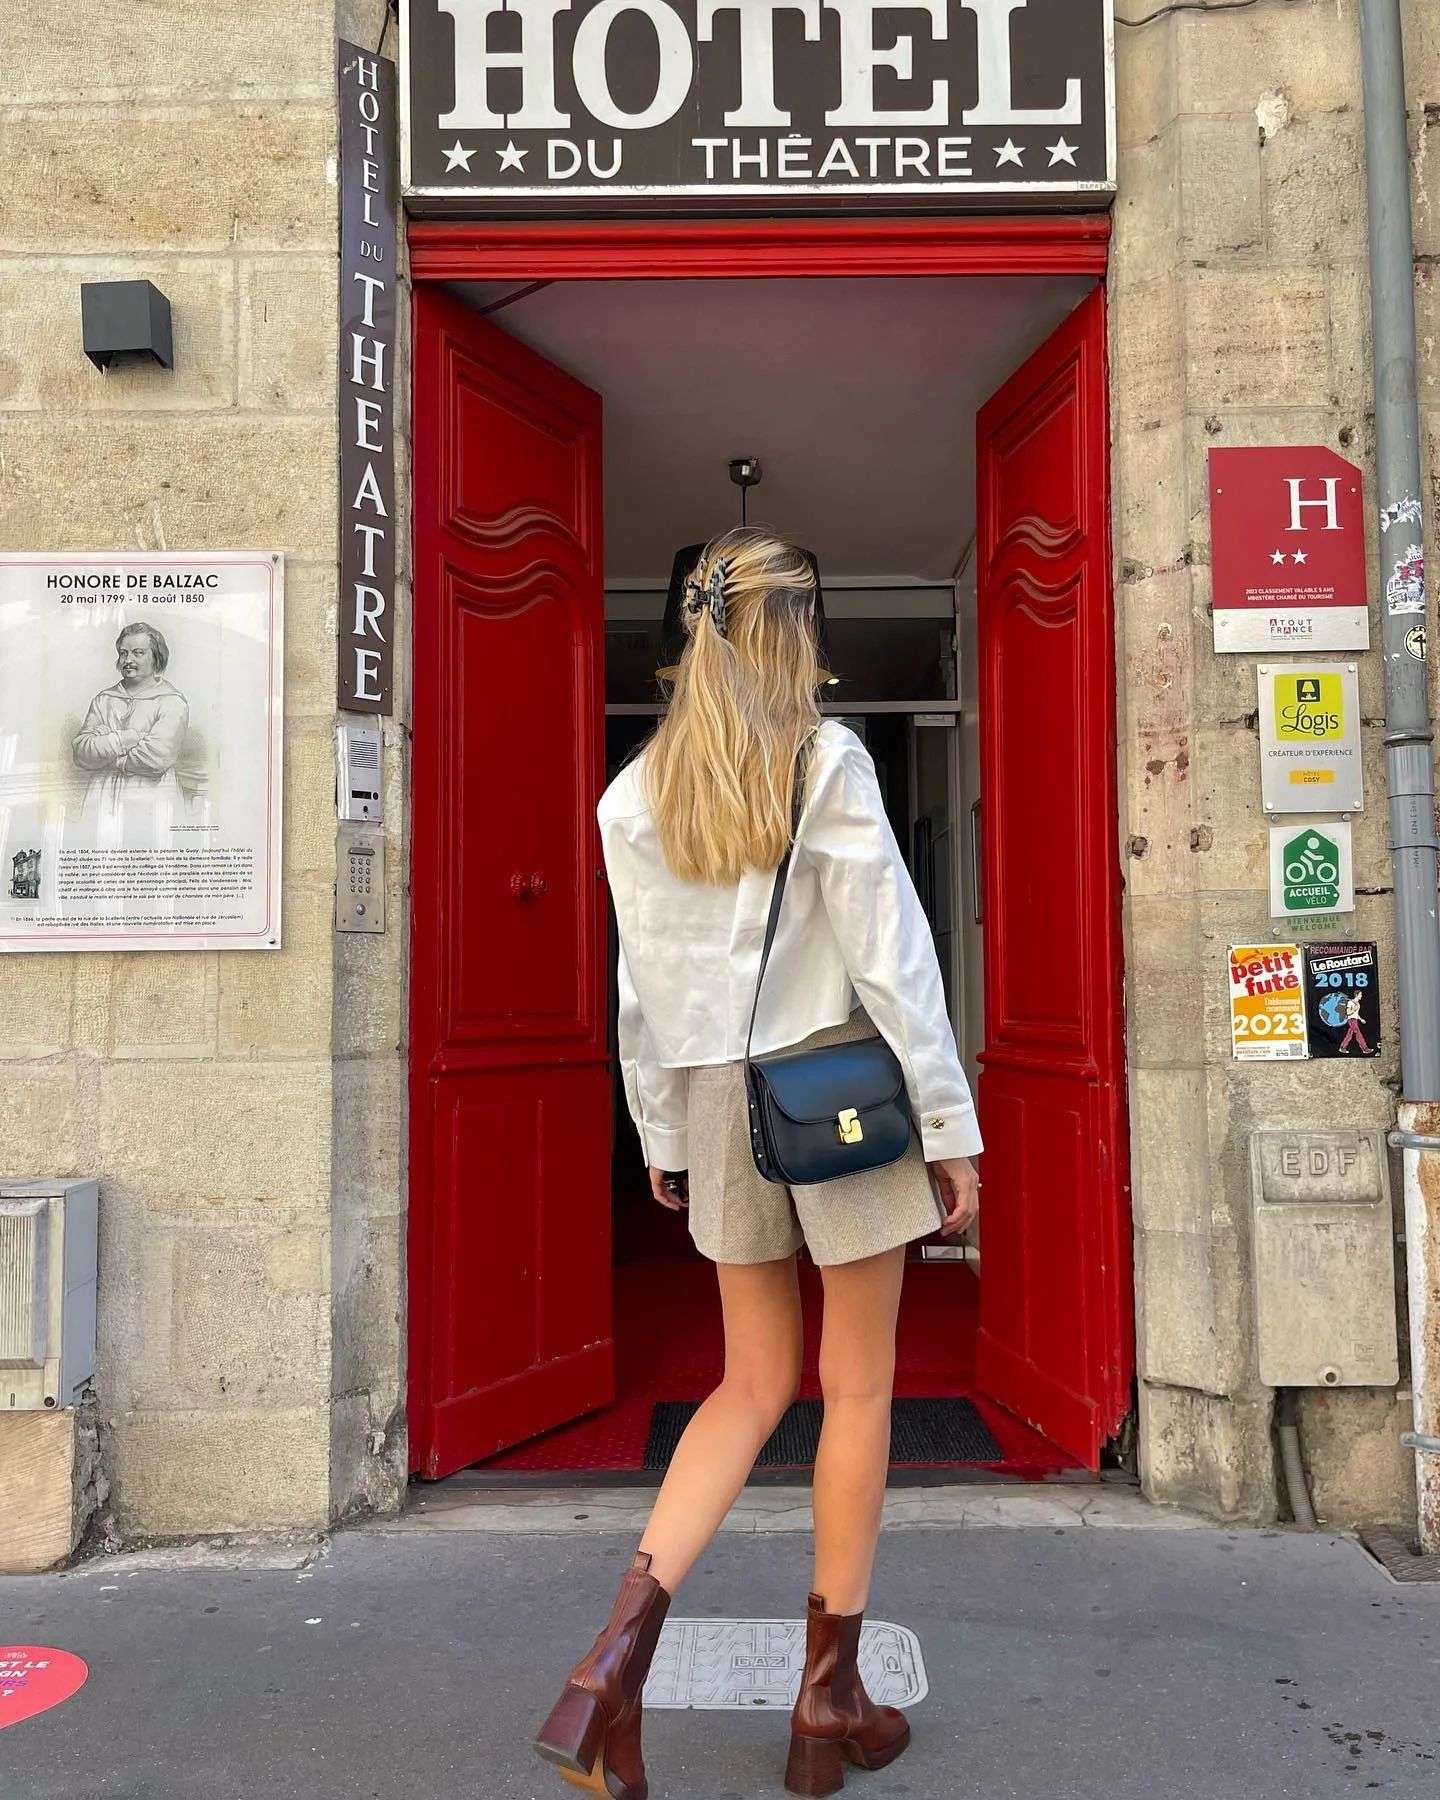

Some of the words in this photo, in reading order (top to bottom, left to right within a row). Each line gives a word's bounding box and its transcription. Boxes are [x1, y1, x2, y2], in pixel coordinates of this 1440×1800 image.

[438, 0, 1082, 129] HOTEL
[356, 56, 380, 228] HOTEL
[547, 138, 622, 179] DU
[360, 240, 384, 263] DU
[350, 272, 388, 702] THEATRE
[1283, 477, 1345, 531] H
[47, 575, 120, 589] HONORE
[126, 575, 148, 588] DE
[153, 574, 219, 588] BALZAC
[60, 594, 74, 604] 20
[77, 594, 97, 604] mai
[101, 594, 125, 604] 1799
[137, 594, 149, 604] 18
[152, 593, 177, 603] août
[180, 593, 205, 603] 1850
[1269, 618, 1313, 627] ATOUT
[1270, 626, 1313, 634] FRANCE
[1280, 704, 1339, 736] Logis
[1289, 886, 1330, 897] ACCUEIL
[1305, 896, 1327, 905] VÉLO
[1287, 915, 1340, 925] BIENVENUE
[1292, 922, 1337, 932] WELCOME
[1231, 951, 1294, 984] petit
[1245, 970, 1299, 996] futé
[1315, 973, 1368, 987] 2018
[1234, 1013, 1304, 1035] 2023
[1281, 1147, 1356, 1176] EDF
[24, 1661, 49, 1669] LE
[736, 1656, 785, 1668] GAZ
